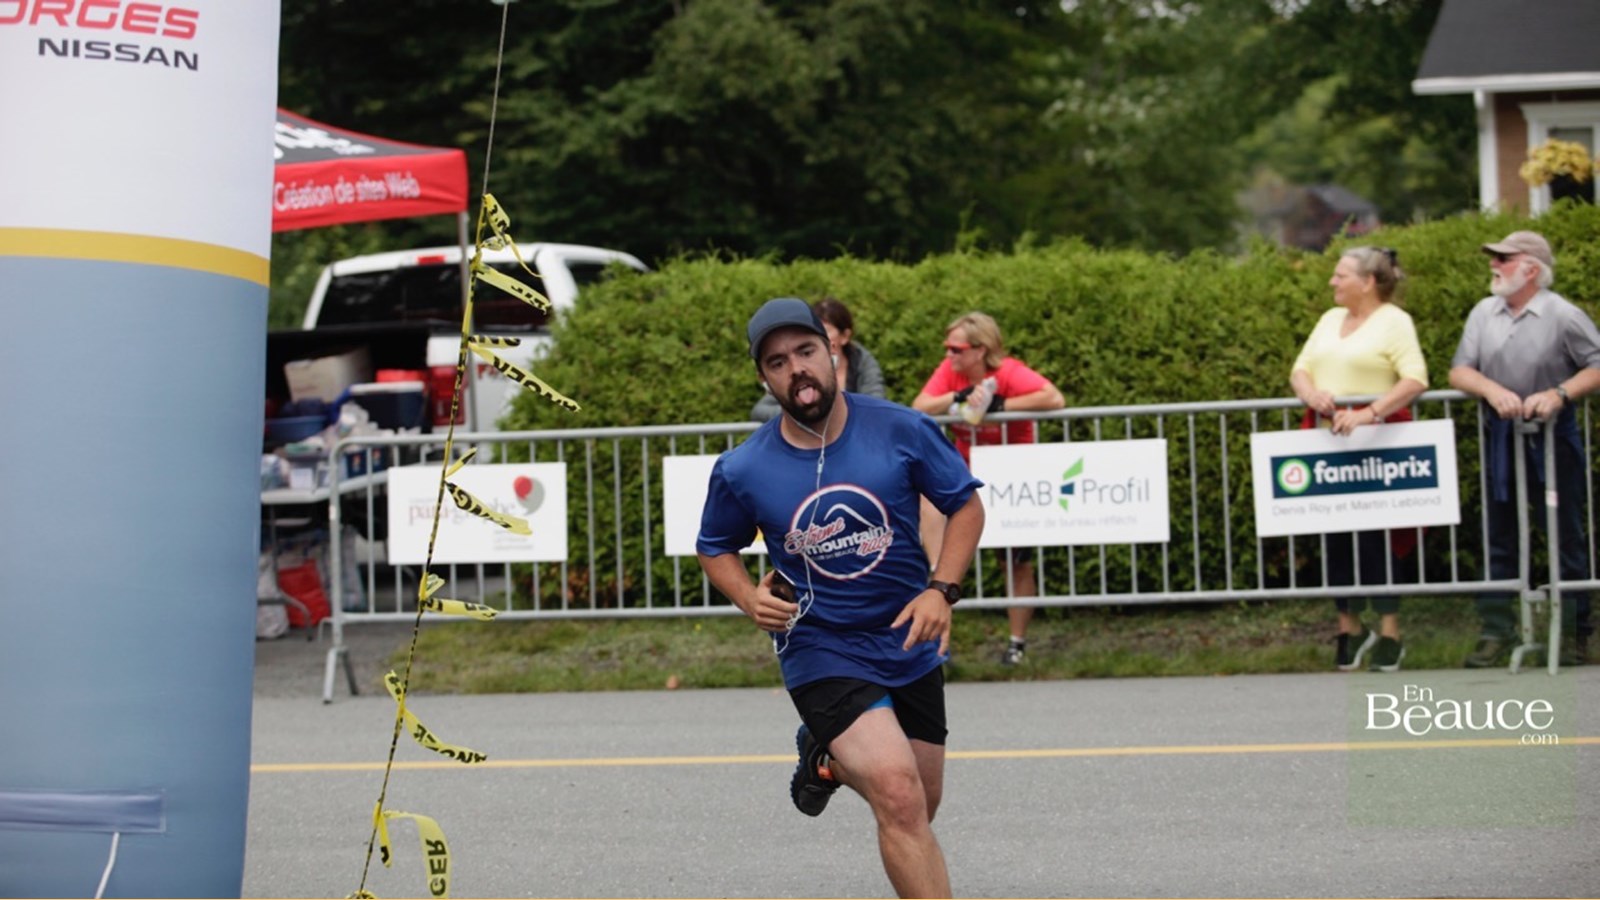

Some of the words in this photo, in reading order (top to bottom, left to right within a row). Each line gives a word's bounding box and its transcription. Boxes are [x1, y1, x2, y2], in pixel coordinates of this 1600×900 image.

[38, 38, 199, 71] NISSAN
[274, 179, 333, 212] Création
[334, 174, 354, 204] de
[355, 174, 386, 201] sites
[384, 171, 421, 198] Web
[1314, 455, 1431, 486] familiprix
[989, 481, 1052, 507] MAB
[1082, 477, 1150, 505] Profil
[1272, 504, 1305, 517] Denis
[1309, 502, 1331, 515] Roy
[1335, 501, 1347, 512] et
[1351, 498, 1388, 511] Martin
[806, 527, 884, 556] mountain
